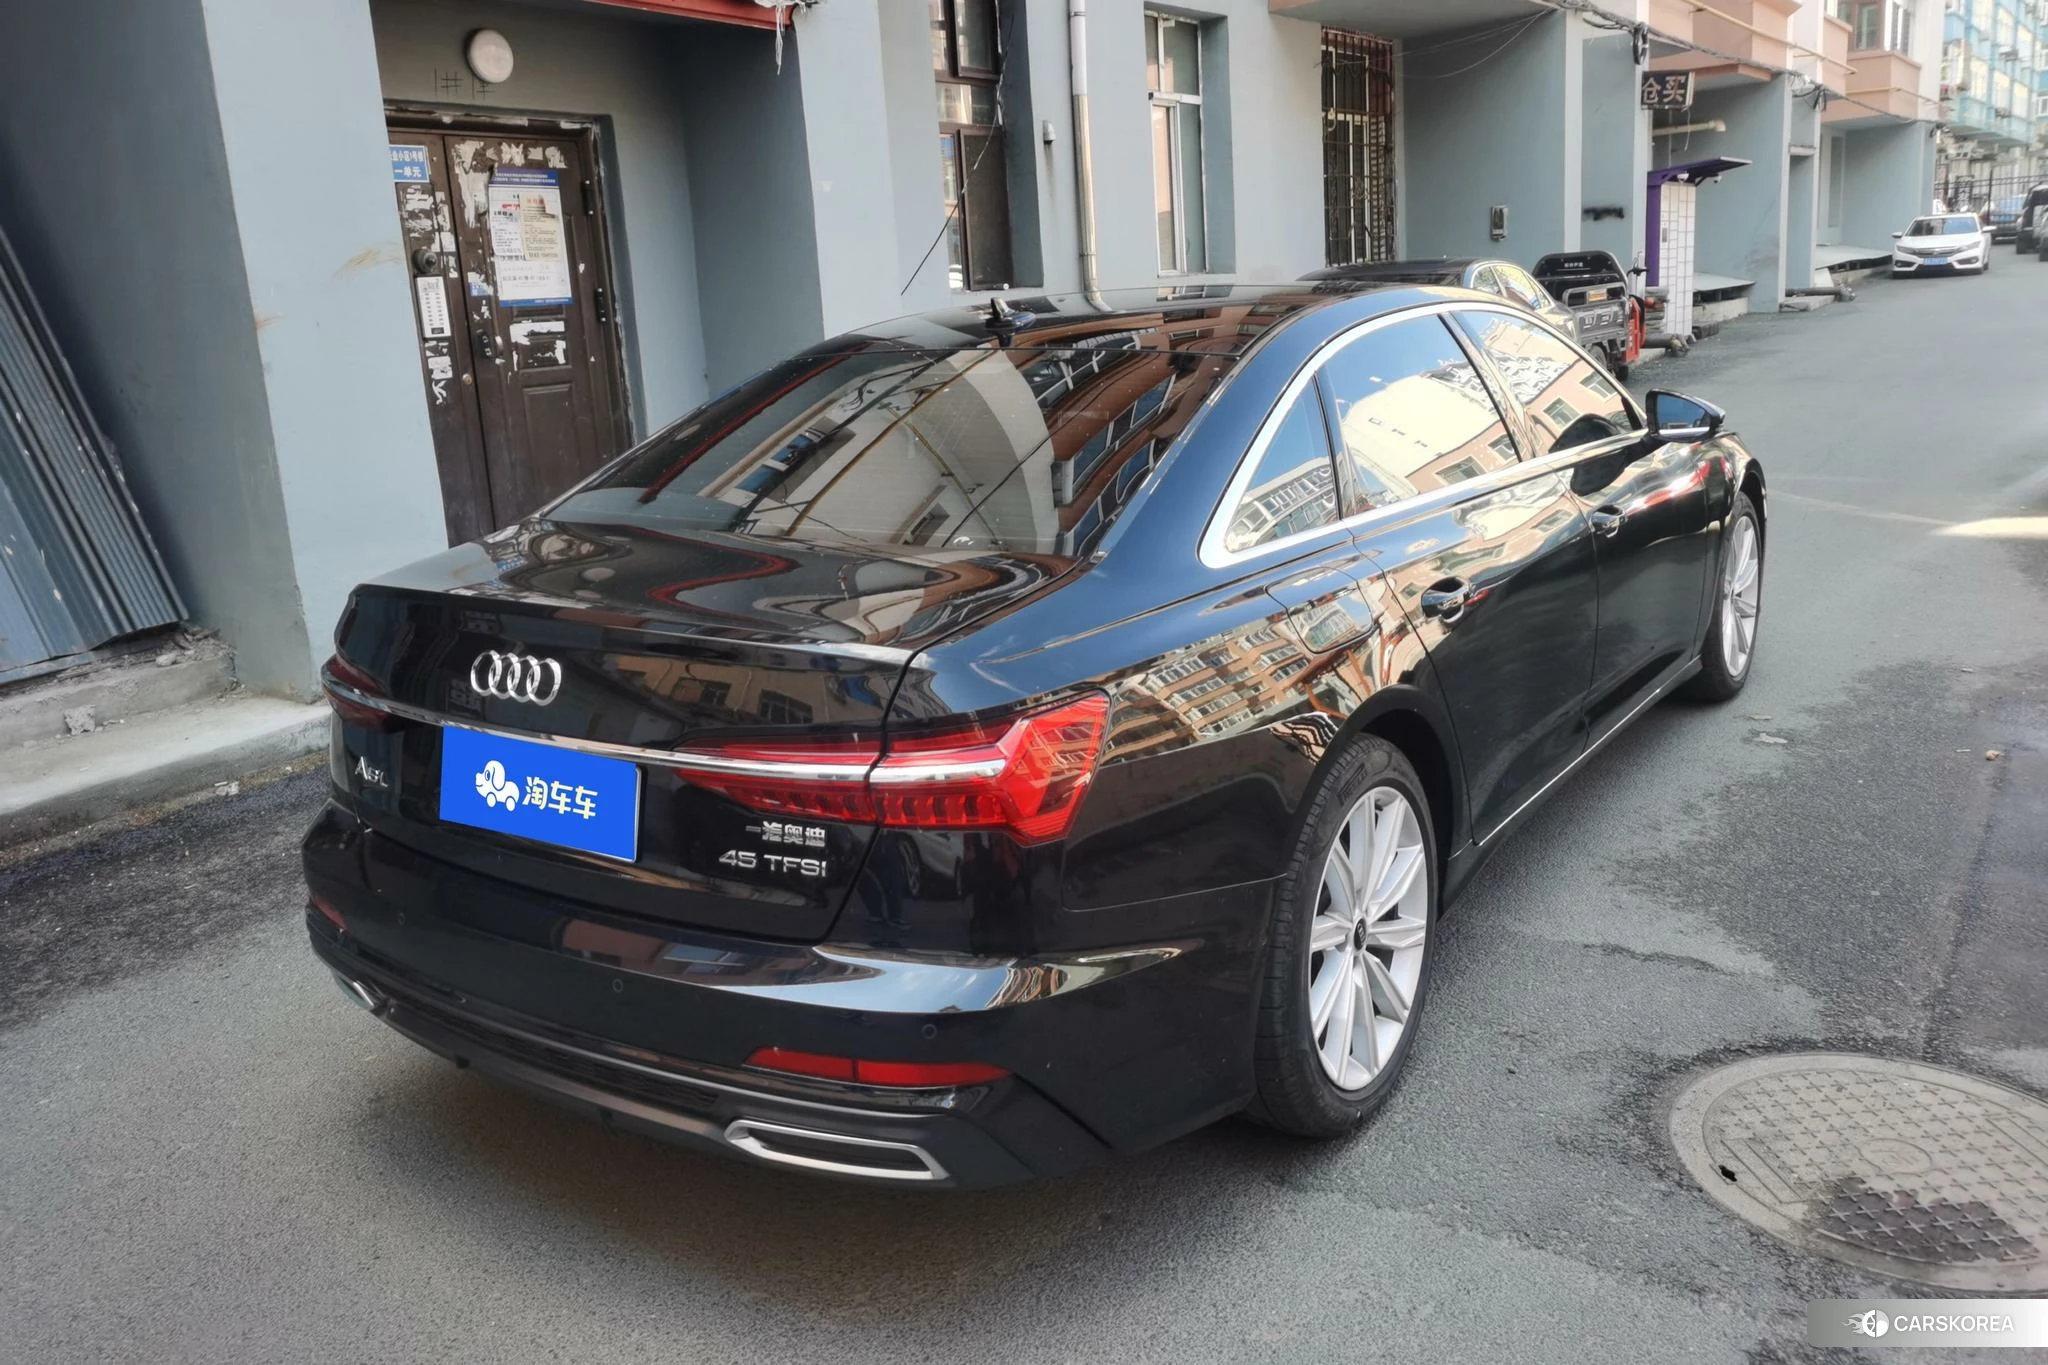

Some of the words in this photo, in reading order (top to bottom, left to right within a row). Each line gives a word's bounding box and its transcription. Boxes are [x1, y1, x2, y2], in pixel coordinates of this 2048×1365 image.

[1642, 76, 1686, 104] 仓买
[394, 166, 422, 178] 一单元
[355, 755, 388, 788] A6L
[745, 821, 826, 848] 一汽奥迪
[719, 849, 757, 869] 45
[763, 854, 827, 877] TFSI
